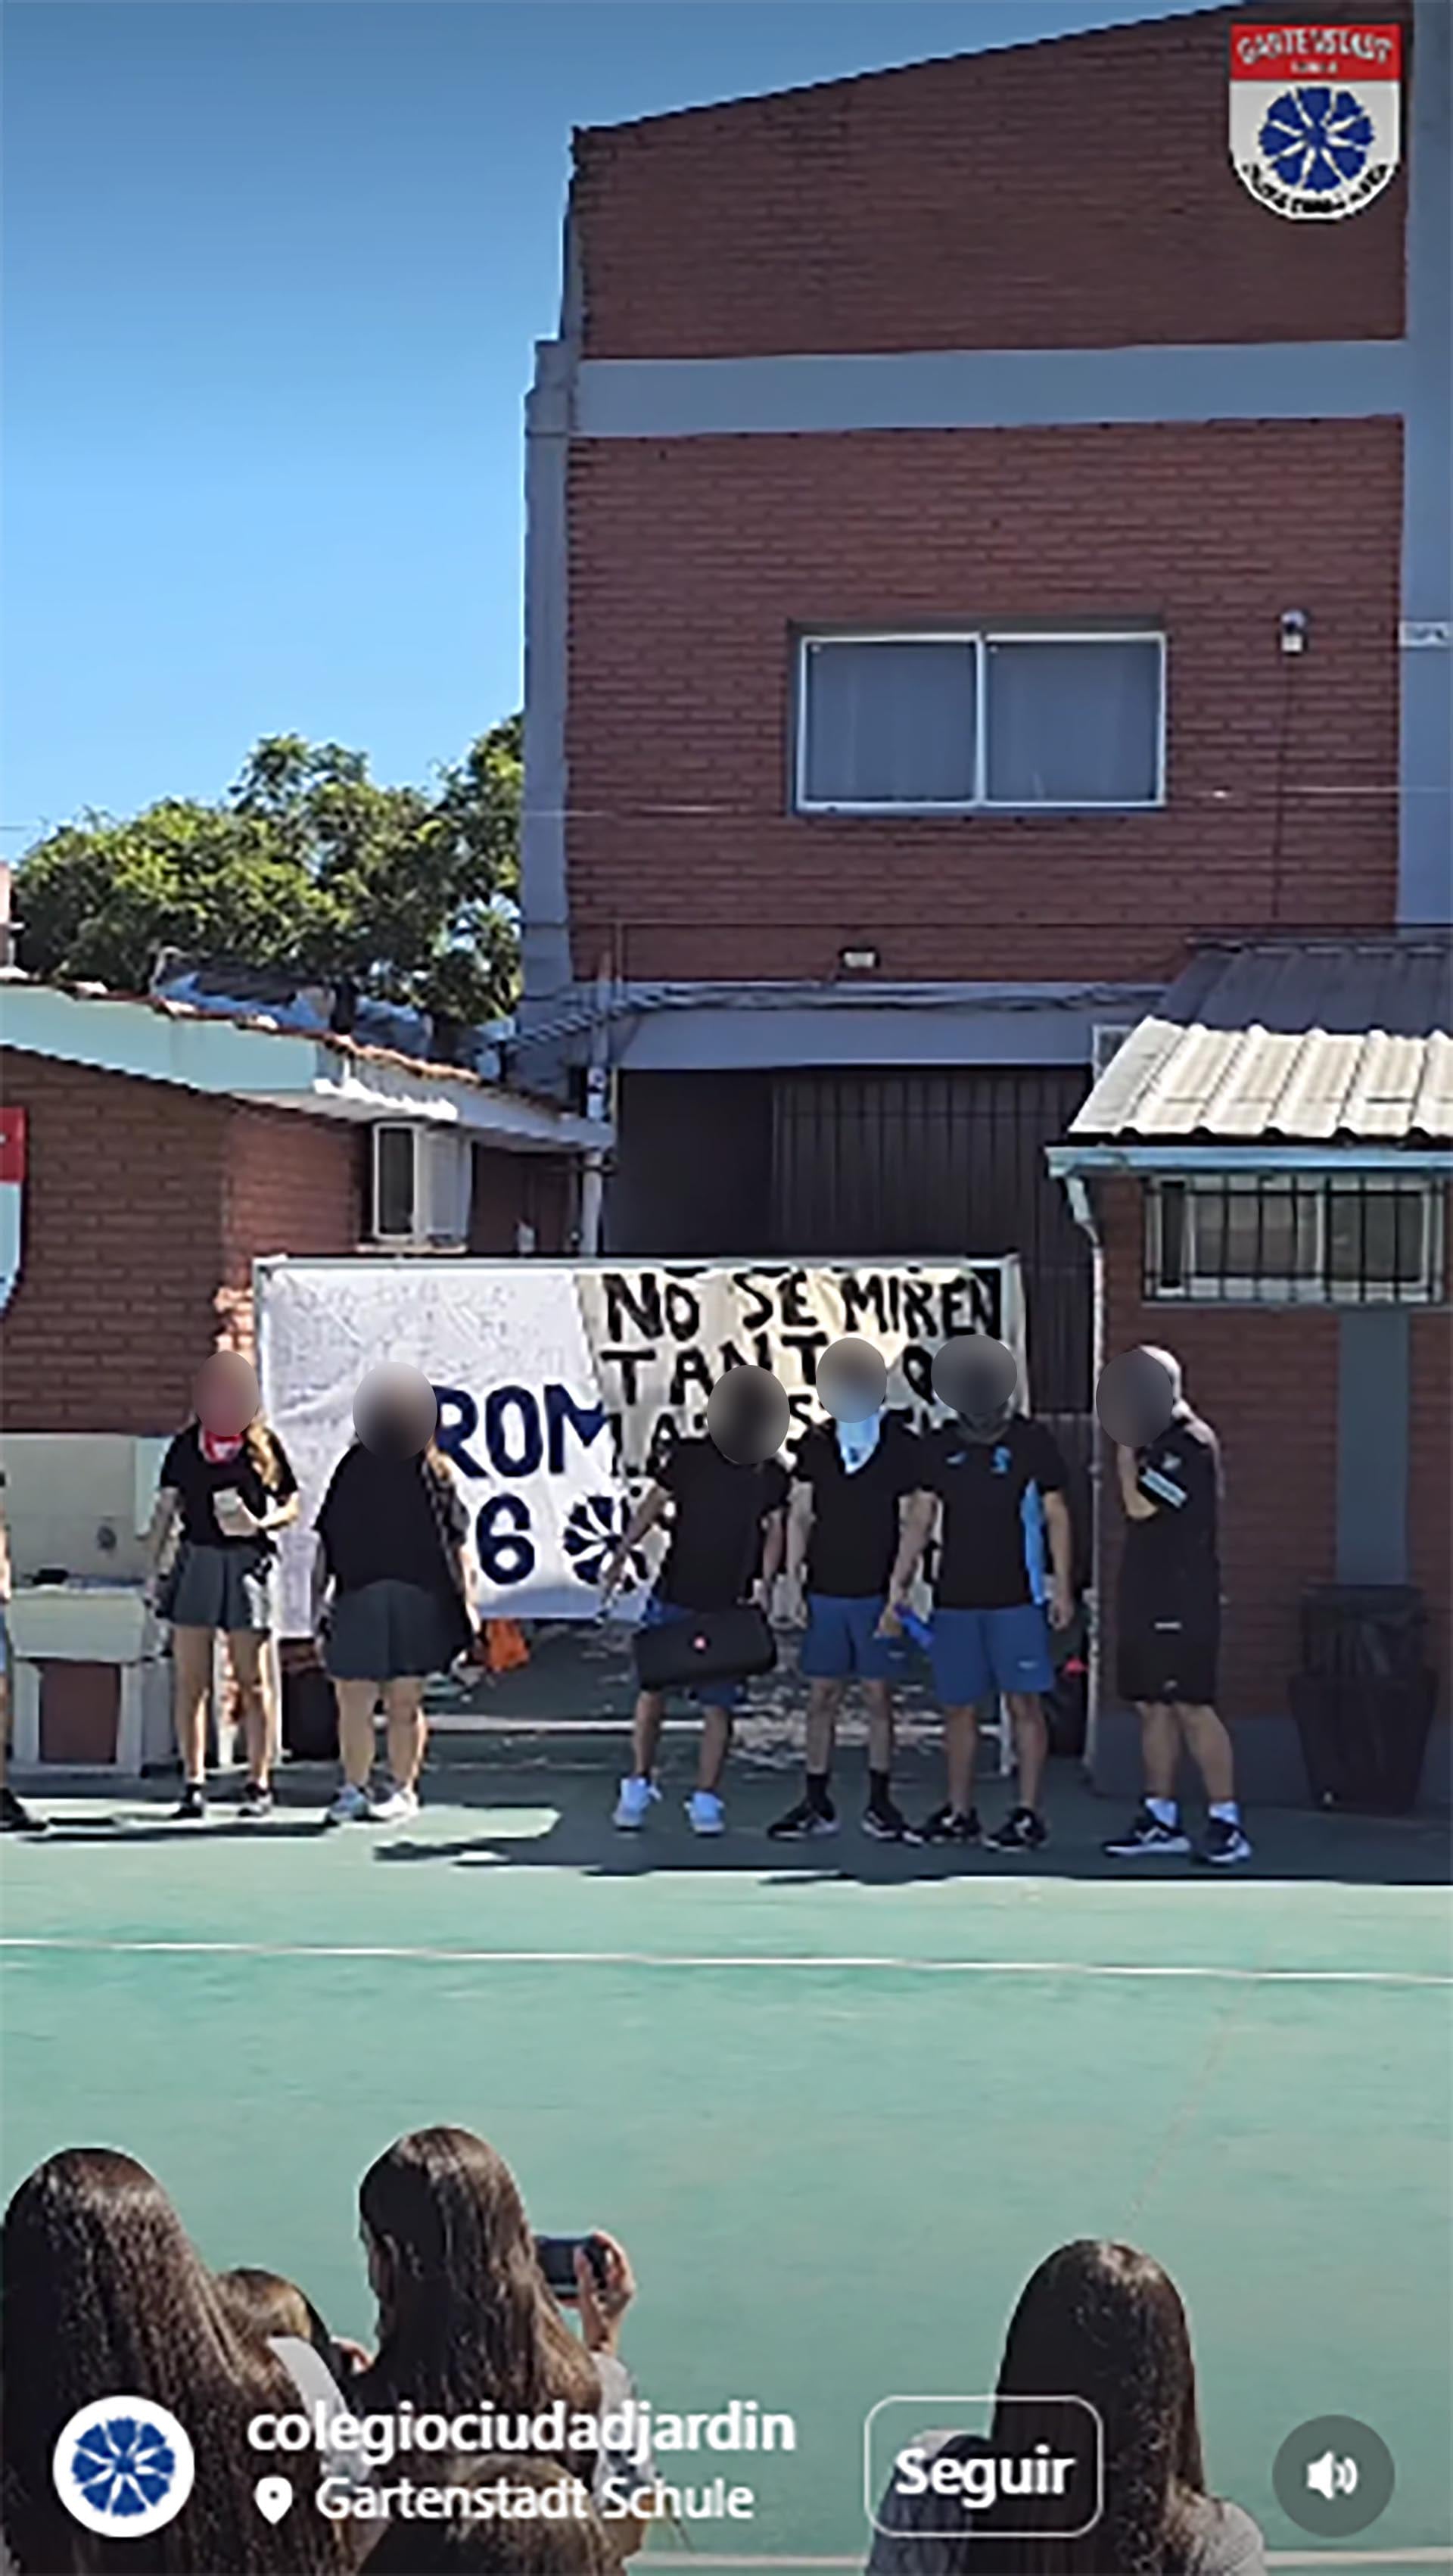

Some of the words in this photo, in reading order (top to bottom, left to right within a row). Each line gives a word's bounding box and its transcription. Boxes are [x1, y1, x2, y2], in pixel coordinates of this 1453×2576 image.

[602, 1272, 700, 1343] NO
[732, 1269, 817, 1332] SE
[840, 1268, 1001, 1341] MIREN
[599, 1332, 829, 1406] TANT
